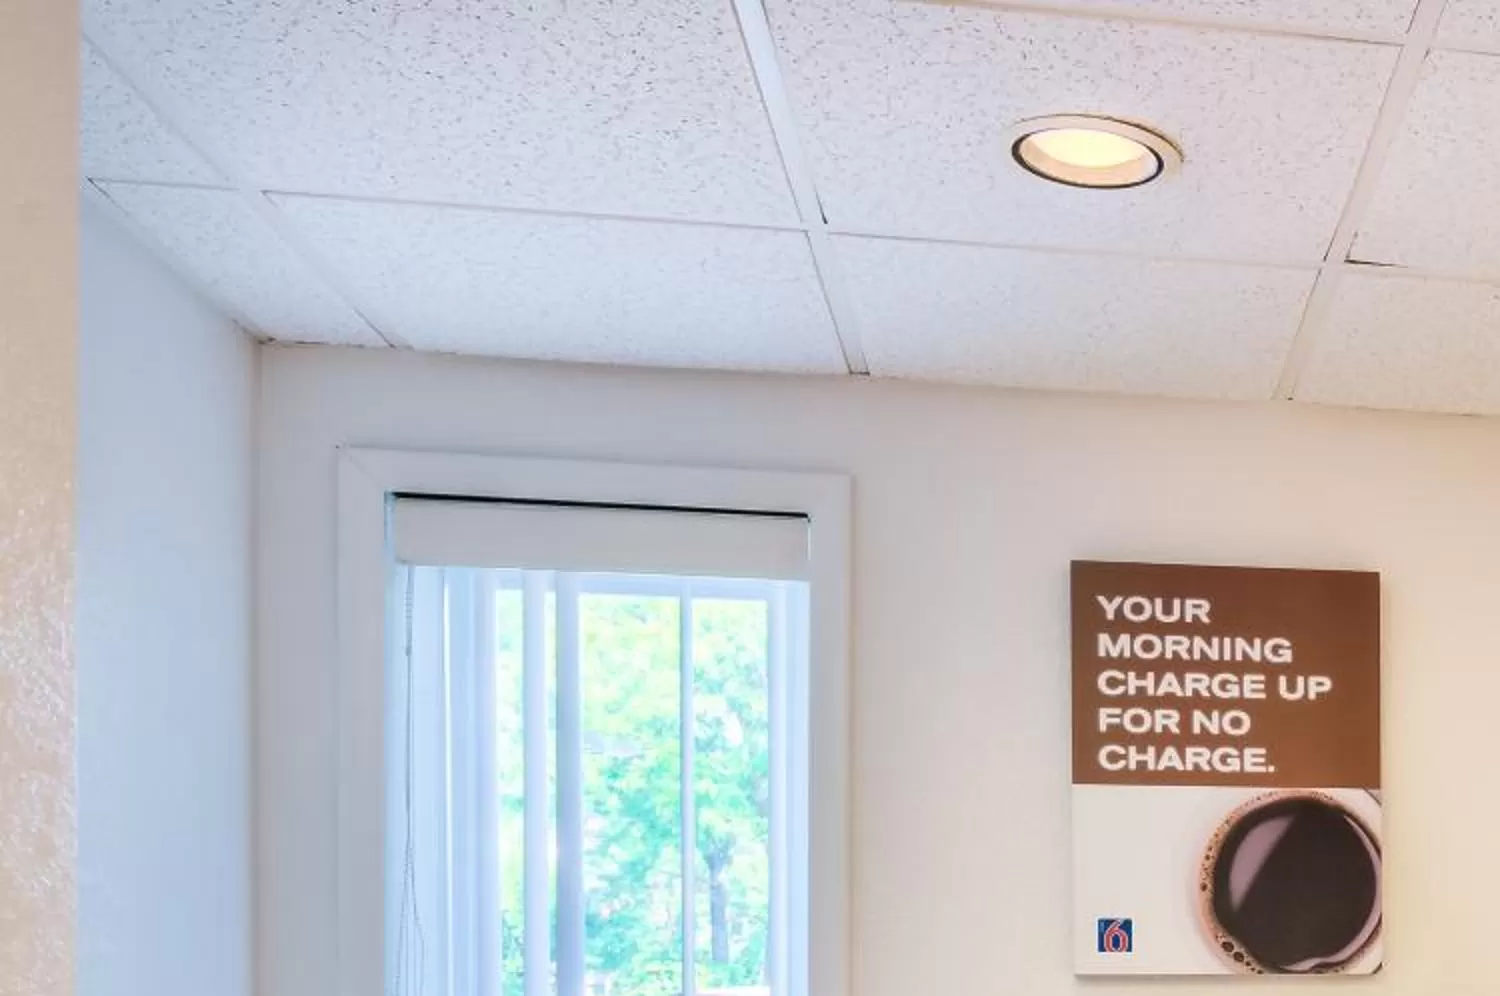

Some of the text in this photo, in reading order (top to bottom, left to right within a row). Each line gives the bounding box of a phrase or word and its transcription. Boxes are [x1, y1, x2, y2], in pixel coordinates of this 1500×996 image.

[1096, 594, 1211, 624] YOUR
[1097, 633, 1293, 663] MORNING
[1097, 670, 1333, 701] CHARGE UP
[1098, 707, 1252, 735] FOR NO
[1098, 744, 1275, 773] CHARGE.
[1103, 919, 1129, 952] 6
